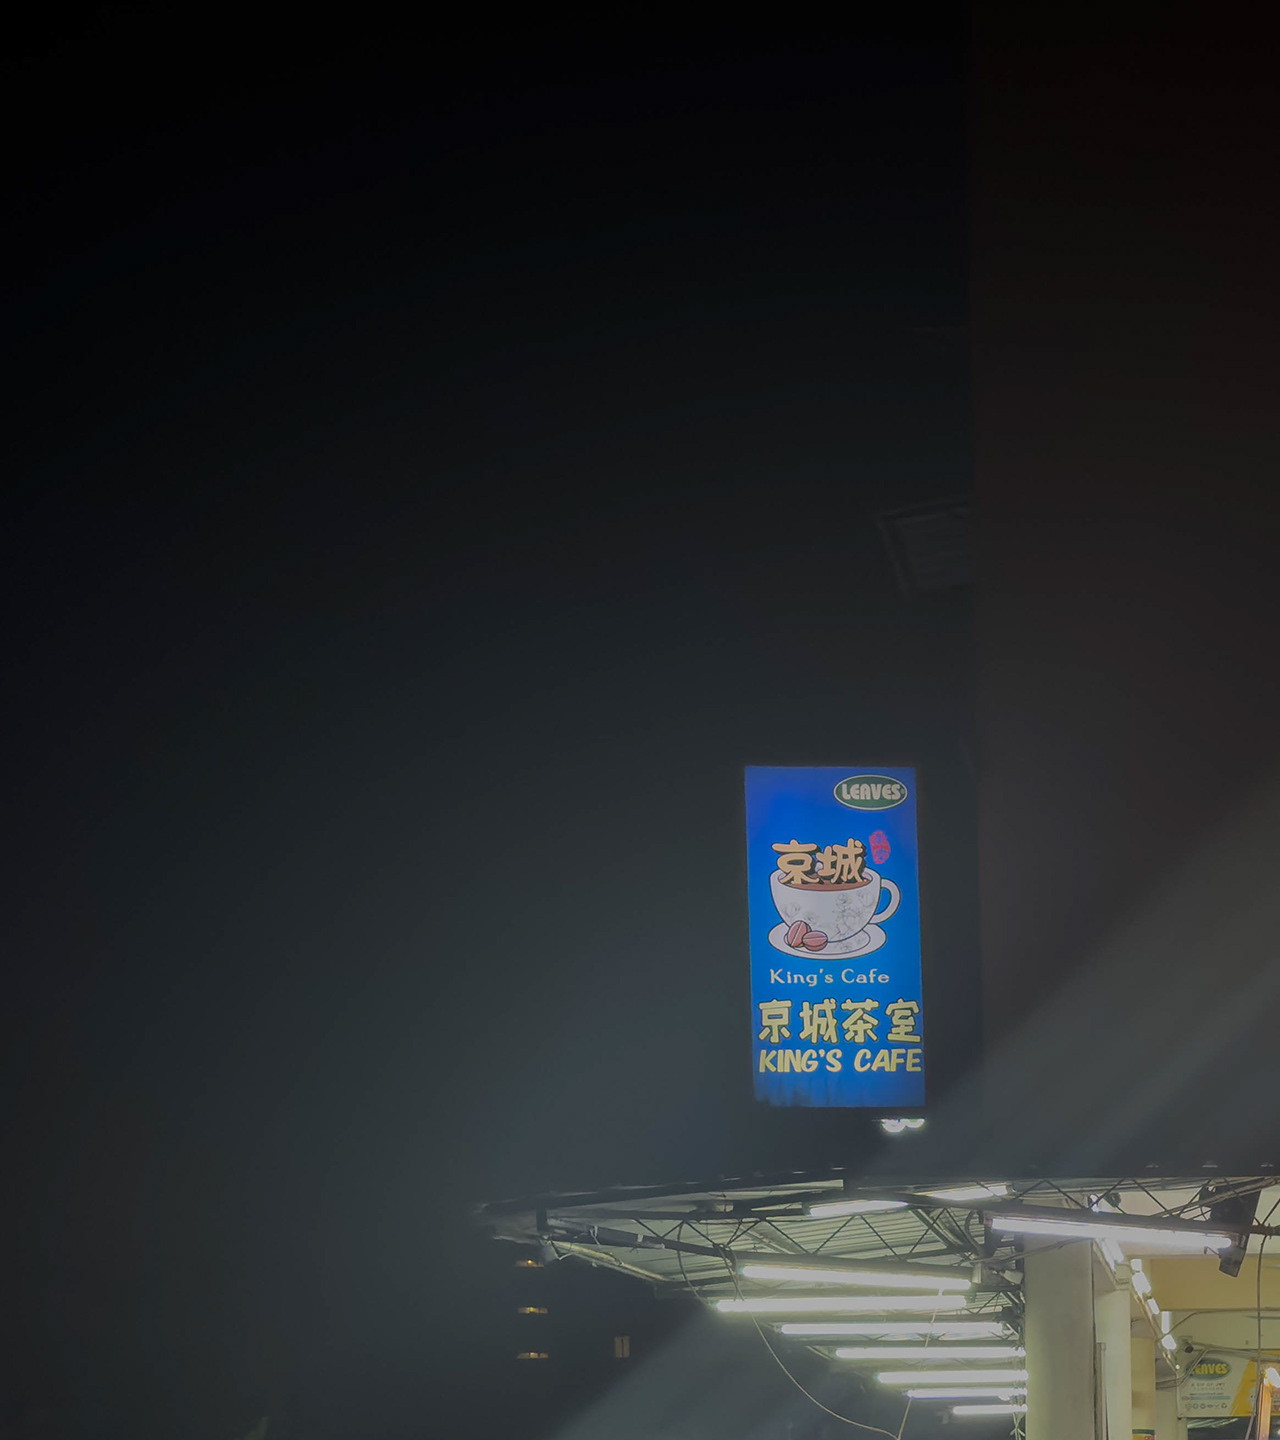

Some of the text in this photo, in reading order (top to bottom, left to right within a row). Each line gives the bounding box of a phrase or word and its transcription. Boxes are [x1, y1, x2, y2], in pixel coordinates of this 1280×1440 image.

[842, 783, 901, 800] LEAVES
[771, 838, 868, 885] 京城
[769, 968, 890, 987] King's Cafe
[758, 998, 922, 1044] 京城茶室
[758, 1048, 922, 1072] KING'S CAFE
